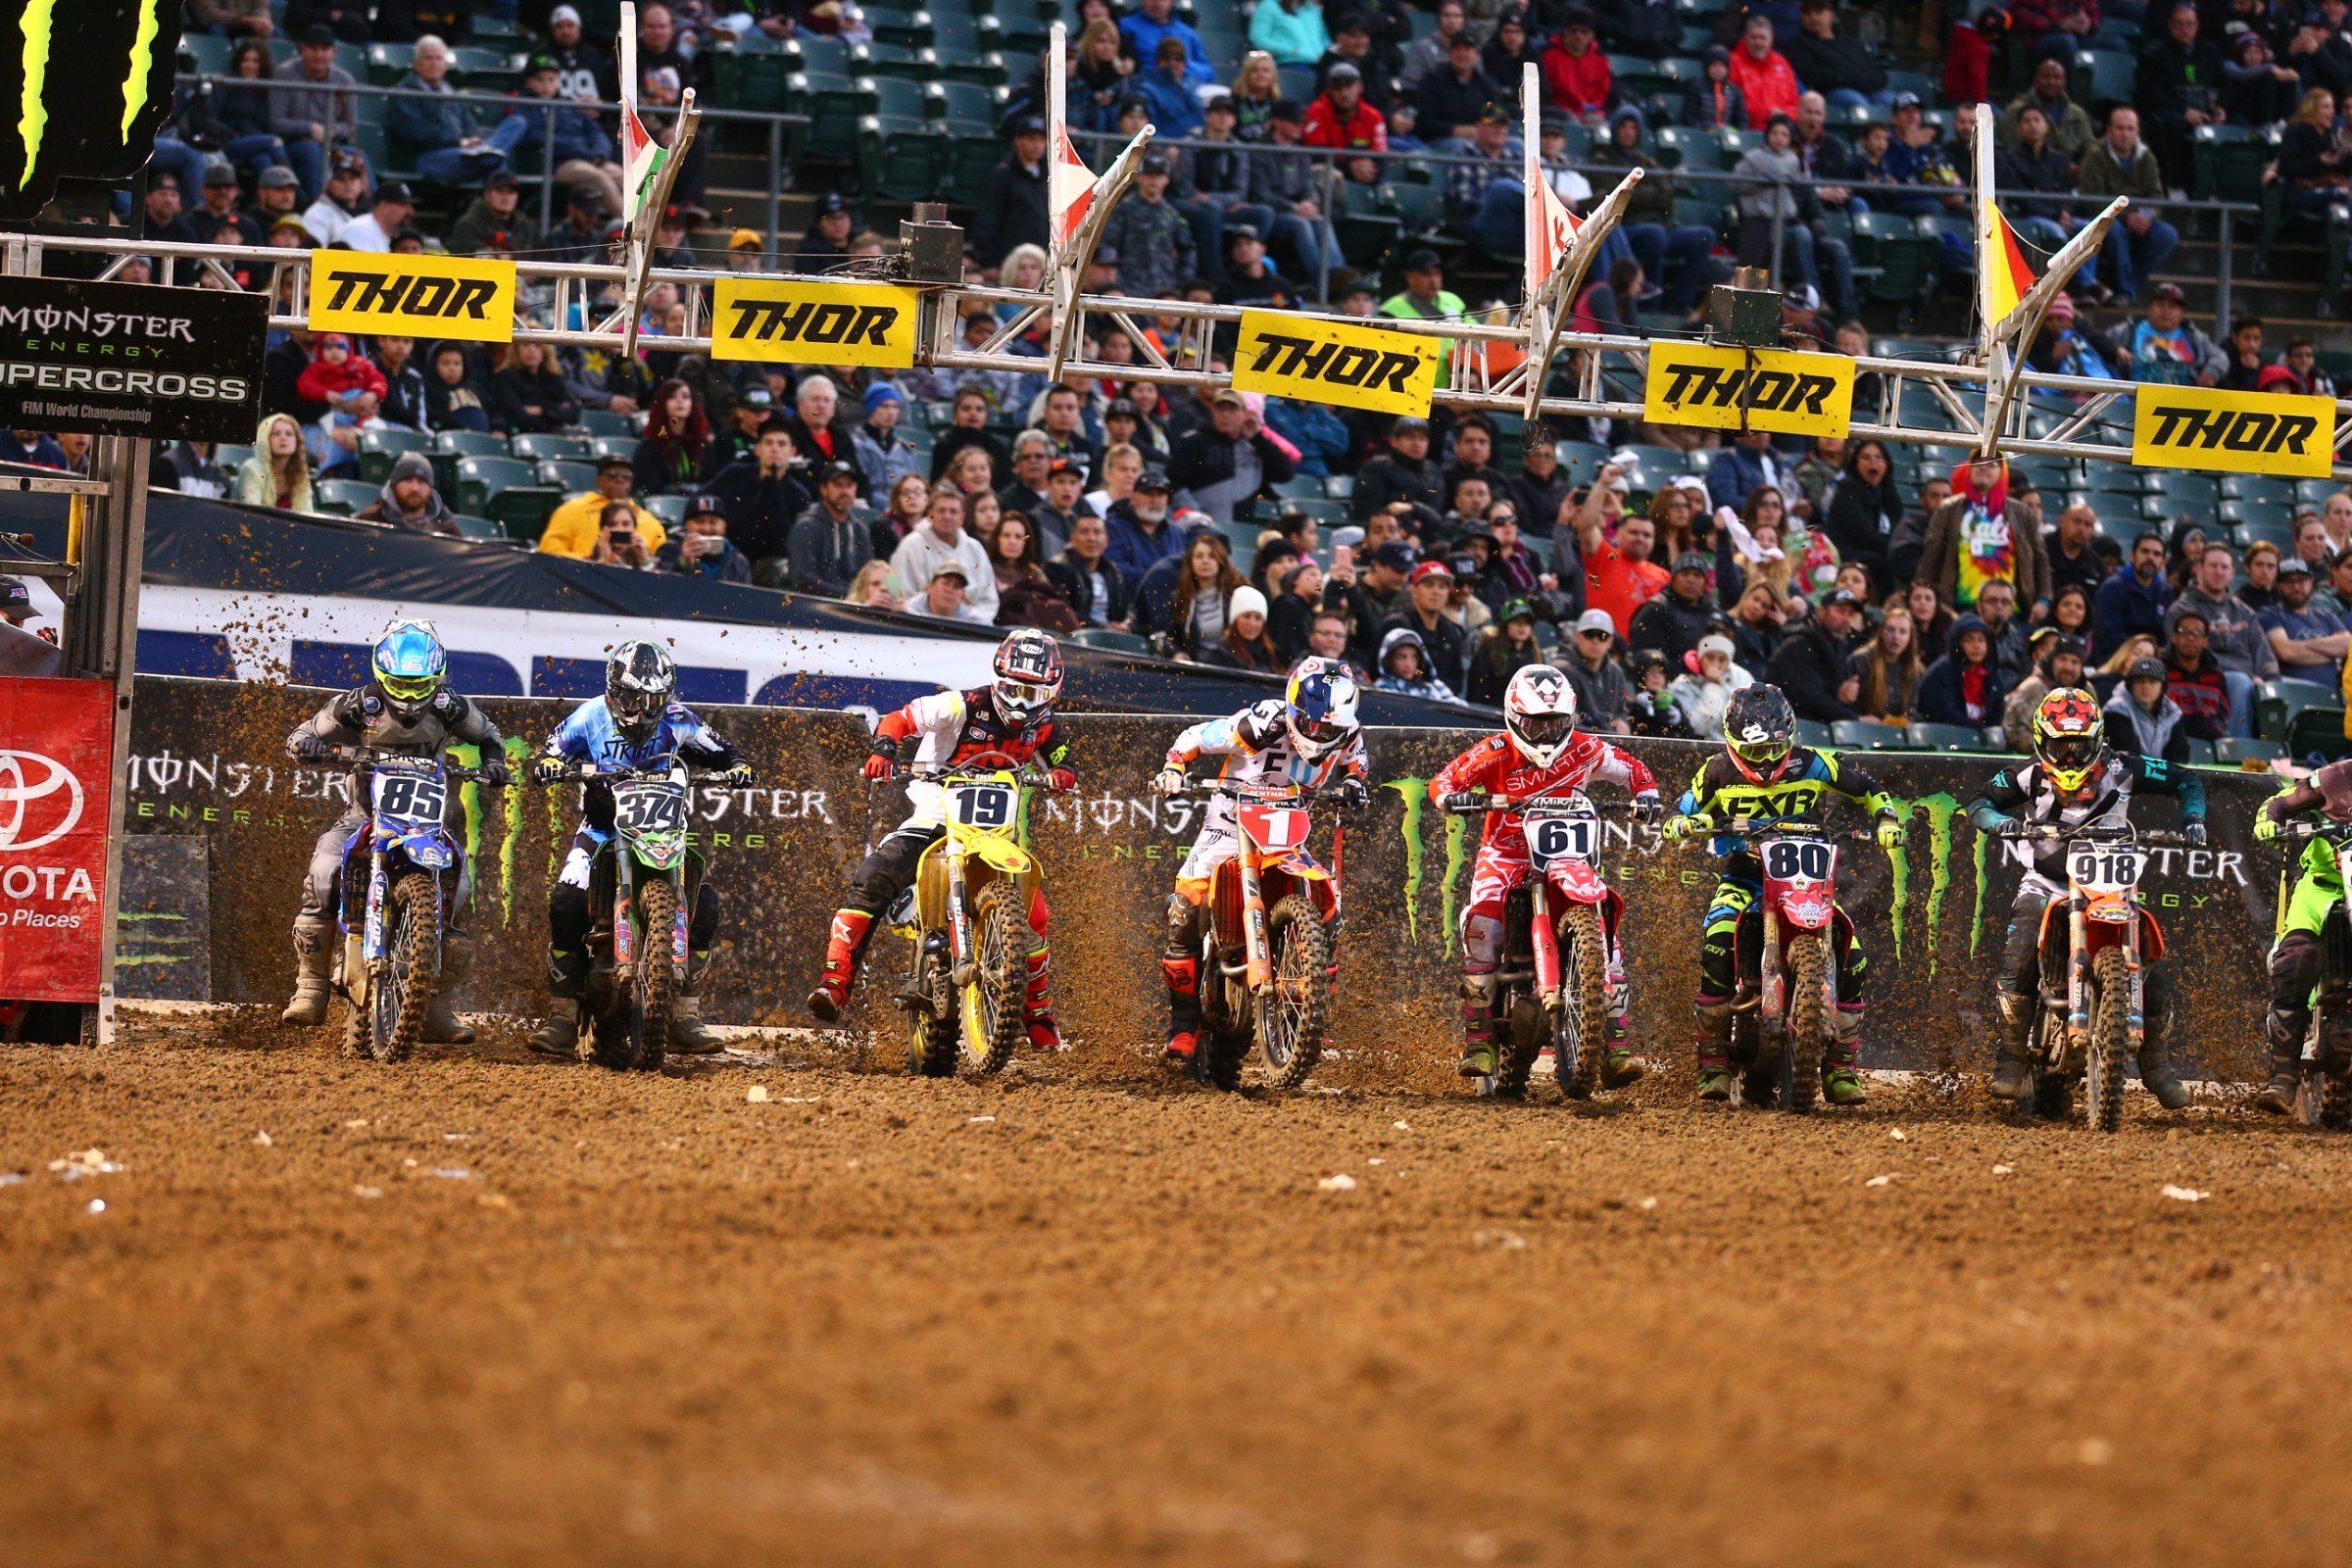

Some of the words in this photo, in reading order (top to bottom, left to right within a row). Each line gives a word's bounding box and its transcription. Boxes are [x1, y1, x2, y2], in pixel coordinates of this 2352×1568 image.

[326, 270, 498, 319] THOR
[0, 304, 196, 343] MONSTER
[730, 300, 900, 346] THOR
[25, 339, 165, 358] ENERGY
[1250, 332, 1421, 393] THOR
[0, 363, 247, 401] PERCROSS
[1663, 364, 1838, 416] THOR
[23, 402, 43, 416] FIM
[46, 403, 78, 417] World
[80, 405, 152, 422] Championship
[2150, 407, 2319, 455] THOR
[1741, 723, 1769, 744] 80
[1505, 736, 1599, 792] SMARTOP
[379, 778, 445, 820] 85
[616, 792, 684, 829] 374
[956, 788, 1008, 825] 19
[1727, 788, 1817, 820] FXR
[1258, 809, 1292, 846] 1
[1539, 820, 1589, 855] 61
[1769, 842, 1830, 880] 80
[2075, 855, 2136, 886] 918
[0, 865, 97, 902] OTA
[12, 908, 81, 928] Places
[372, 884, 384, 947] DULOP
